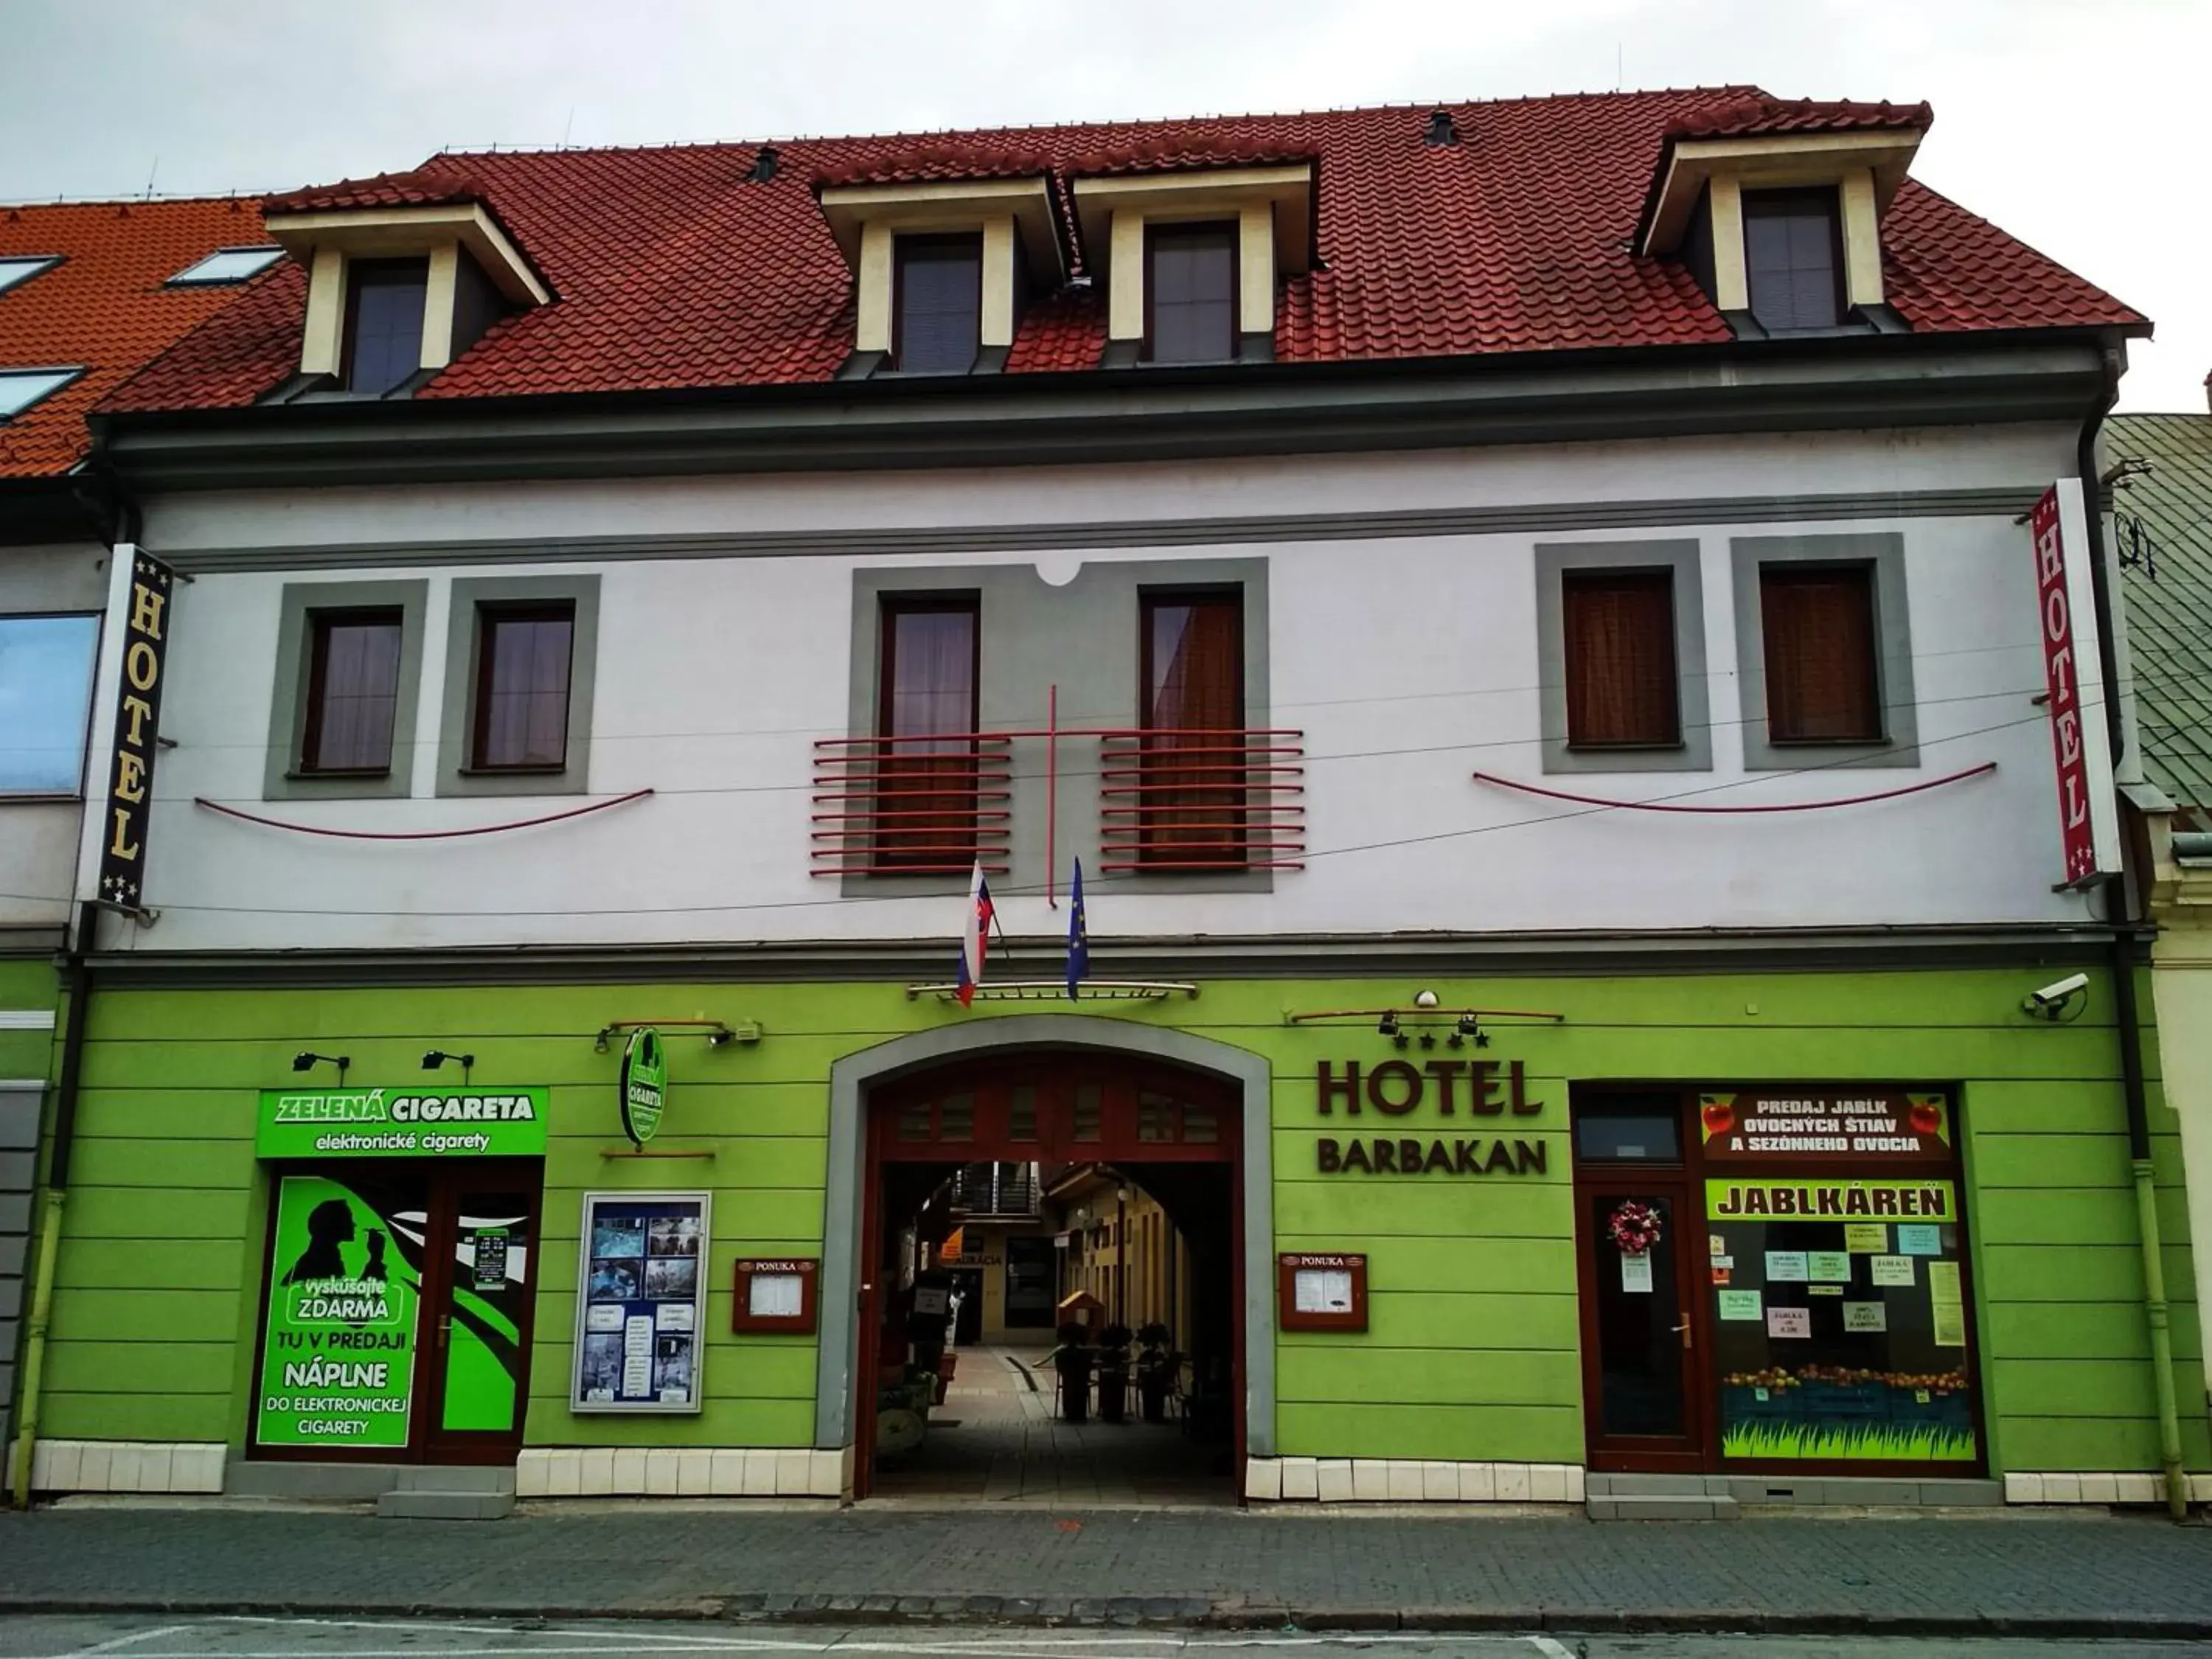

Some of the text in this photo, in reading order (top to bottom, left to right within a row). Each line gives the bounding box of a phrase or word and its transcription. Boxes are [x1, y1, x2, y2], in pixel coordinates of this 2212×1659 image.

[2037, 521, 2086, 829] HOTEL
[111, 582, 166, 861] HOTEL
[1317, 1060, 1544, 1116] HOTEL
[275, 1090, 535, 1122] ZELENÁ CIGARETA
[1757, 1100, 1825, 1114] PREDAJ
[1744, 1116, 1897, 1133] OVOCNÝCH ŠTIAV
[316, 1133, 490, 1153] elektronické cigarety
[1731, 1135, 1920, 1152] A SEZÓNNEHO OVOCIA
[1318, 1138, 1547, 1175] BARBAKAN
[1717, 1181, 1947, 1217] JABLKÁREŇ
[756, 1262, 796, 1271] PONUKA
[1301, 1256, 1343, 1266] PONUKA
[305, 1276, 386, 1298] vyskúšajte
[298, 1299, 389, 1318] ZDARMA
[278, 1332, 405, 1349] TU V PREDAJI
[285, 1356, 389, 1388] NÁPLNE
[266, 1397, 407, 1413] DO ELEKTRONICKEJ
[298, 1419, 369, 1434] CIGARETY
